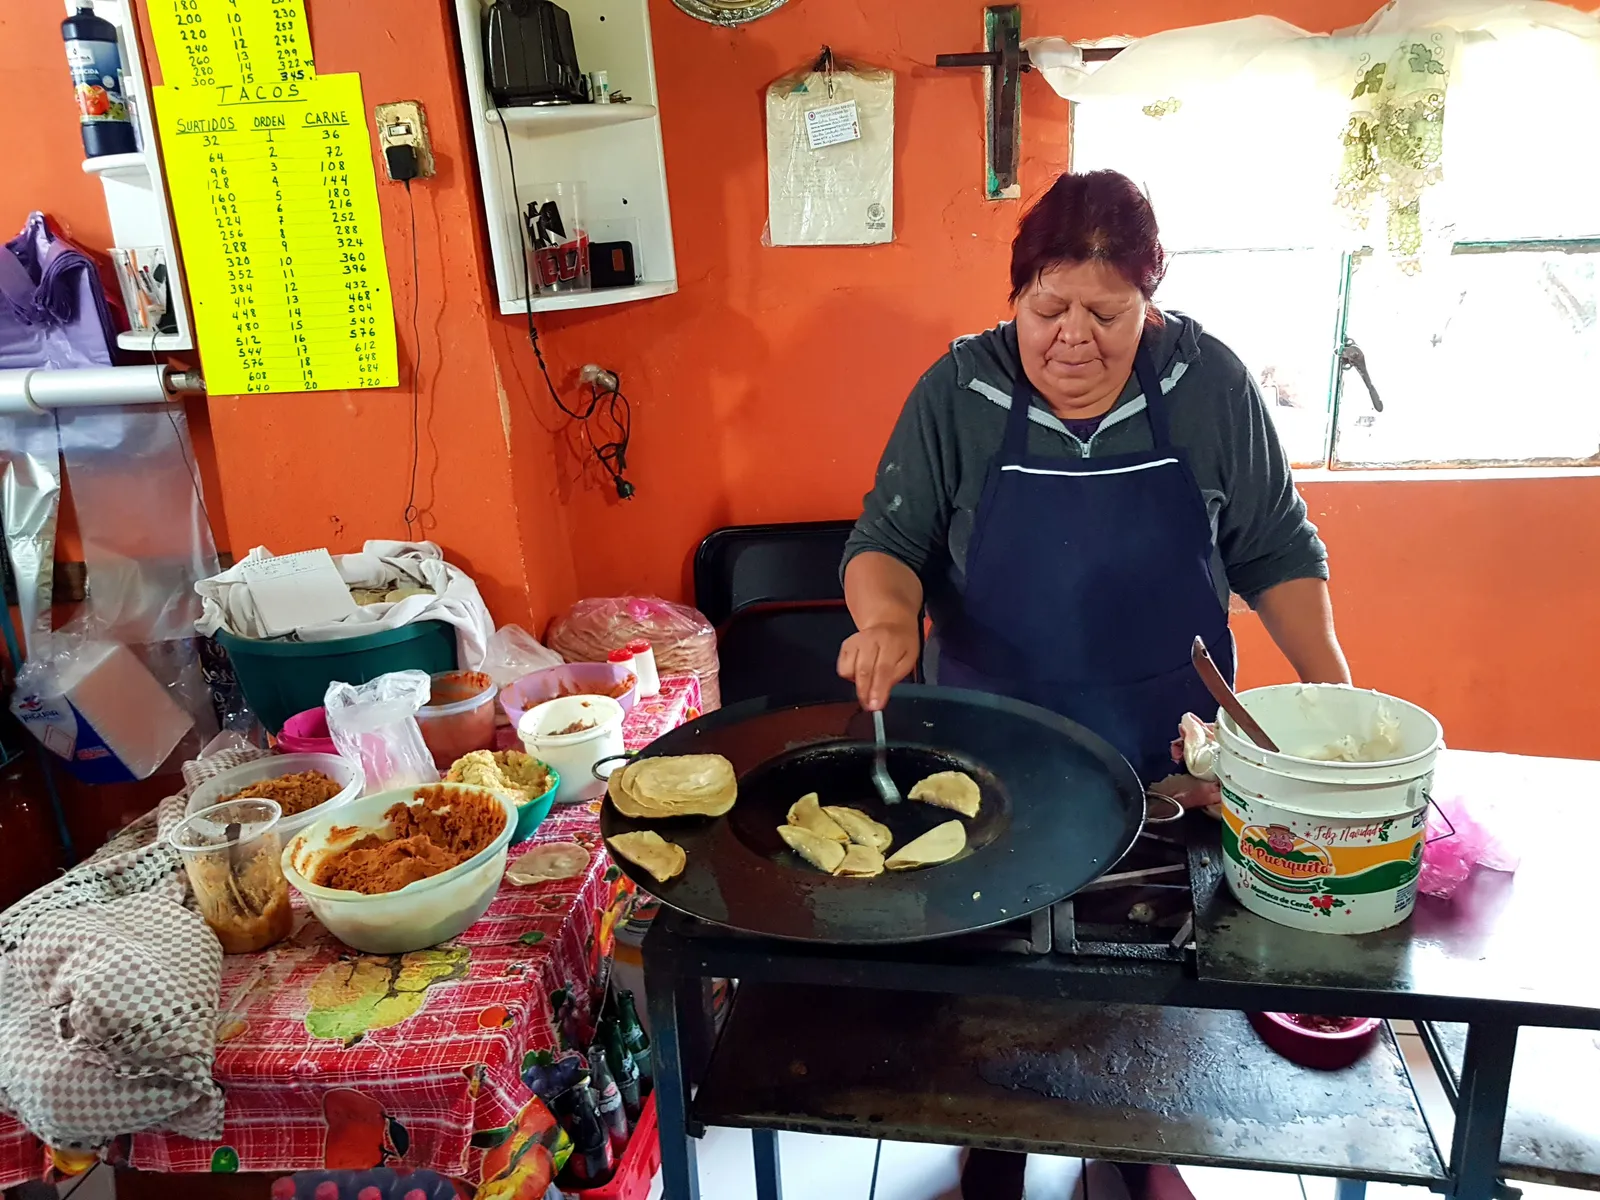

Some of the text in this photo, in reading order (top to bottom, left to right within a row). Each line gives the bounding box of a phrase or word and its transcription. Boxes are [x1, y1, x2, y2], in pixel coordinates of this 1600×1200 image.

[176, 9, 296, 25] 200 10 230
[181, 22, 293, 40] 220 11 253
[186, 35, 295, 54] 240 12 276
[190, 49, 298, 66] 260 13 299
[194, 67, 213, 76] 280
[241, 62, 251, 72] 14
[278, 59, 300, 70] 322
[192, 70, 304, 85] 300 15 345
[216, 84, 299, 103] TACOS
[177, 111, 347, 132] SURTIDOS ORDEN CARNE
[203, 131, 339, 147] 32 1 36
[209, 146, 342, 162] 64 2 72
[211, 161, 345, 177] 96 3 108
[208, 175, 347, 189] 128 4 144
[212, 188, 350, 204] 160 5 180
[215, 199, 352, 215] 192 6 216
[217, 213, 355, 228] 224 7 252
[221, 226, 357, 240] 256 8 288
[223, 239, 363, 254] 288 9 324
[227, 253, 365, 267] 320 10 360
[228, 264, 366, 280] 352 11 396
[231, 280, 367, 294] 384 12 432
[235, 291, 370, 306] 416 13 468
[232, 303, 372, 320] 448 14 504
[237, 317, 374, 332] 480 15 540
[236, 329, 375, 346] 512 16 576
[239, 341, 375, 357] 544 17 612
[243, 353, 376, 368] 576 18 648
[249, 364, 378, 381] 608 19 684
[247, 377, 380, 392] 640 20 720
[1314, 823, 1380, 845] Feliz Navidad
[1241, 839, 1329, 874] El Puerquito
[1251, 884, 1279, 901] Manteca
[1290, 900, 1314, 910] Cerdo
